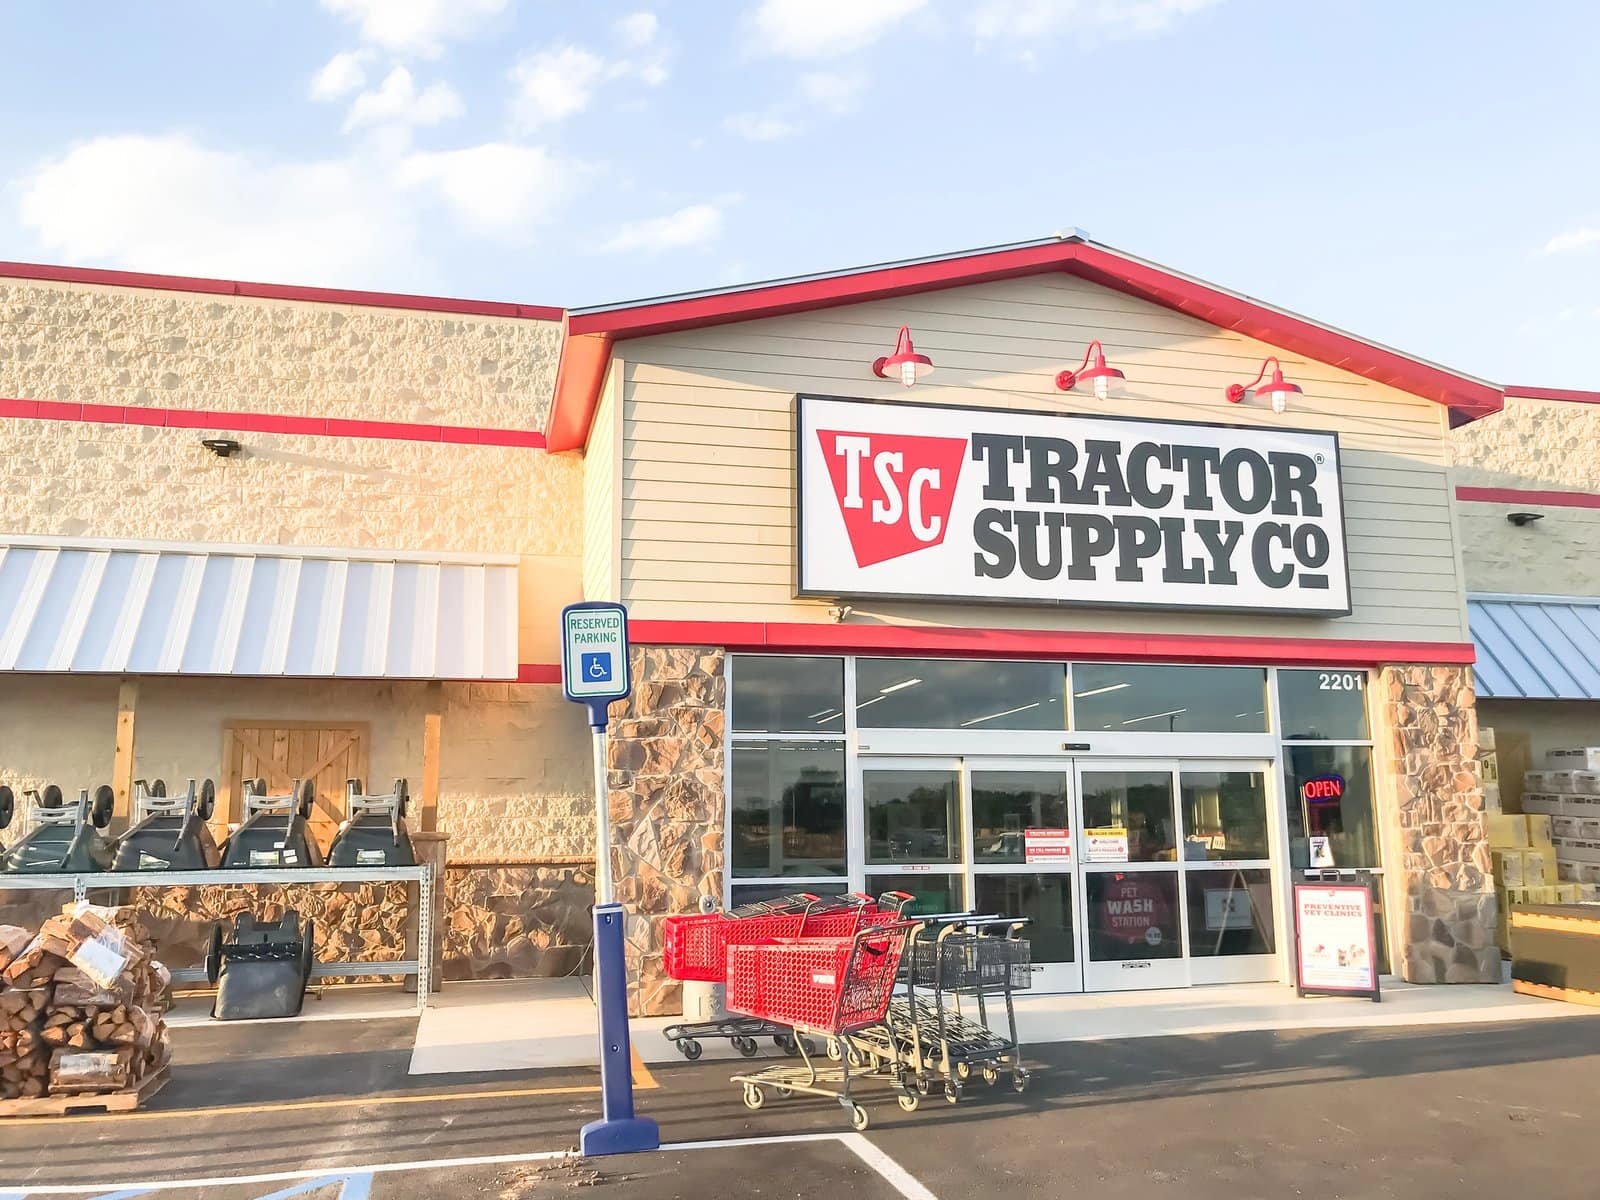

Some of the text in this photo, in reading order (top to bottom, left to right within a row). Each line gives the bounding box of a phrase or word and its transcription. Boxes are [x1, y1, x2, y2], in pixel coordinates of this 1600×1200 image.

[972, 432, 1322, 517] TRACTOR
[835, 435, 941, 542] TSC
[973, 508, 1244, 585] SUPPLY
[570, 618, 619, 629] RESERVED
[574, 632, 617, 643] PARKING
[1319, 674, 1363, 690] 2201
[1305, 780, 1341, 798] OPEN
[1121, 887, 1137, 898] PET
[1107, 899, 1153, 915] WASH
[1112, 916, 1150, 928] STATION
